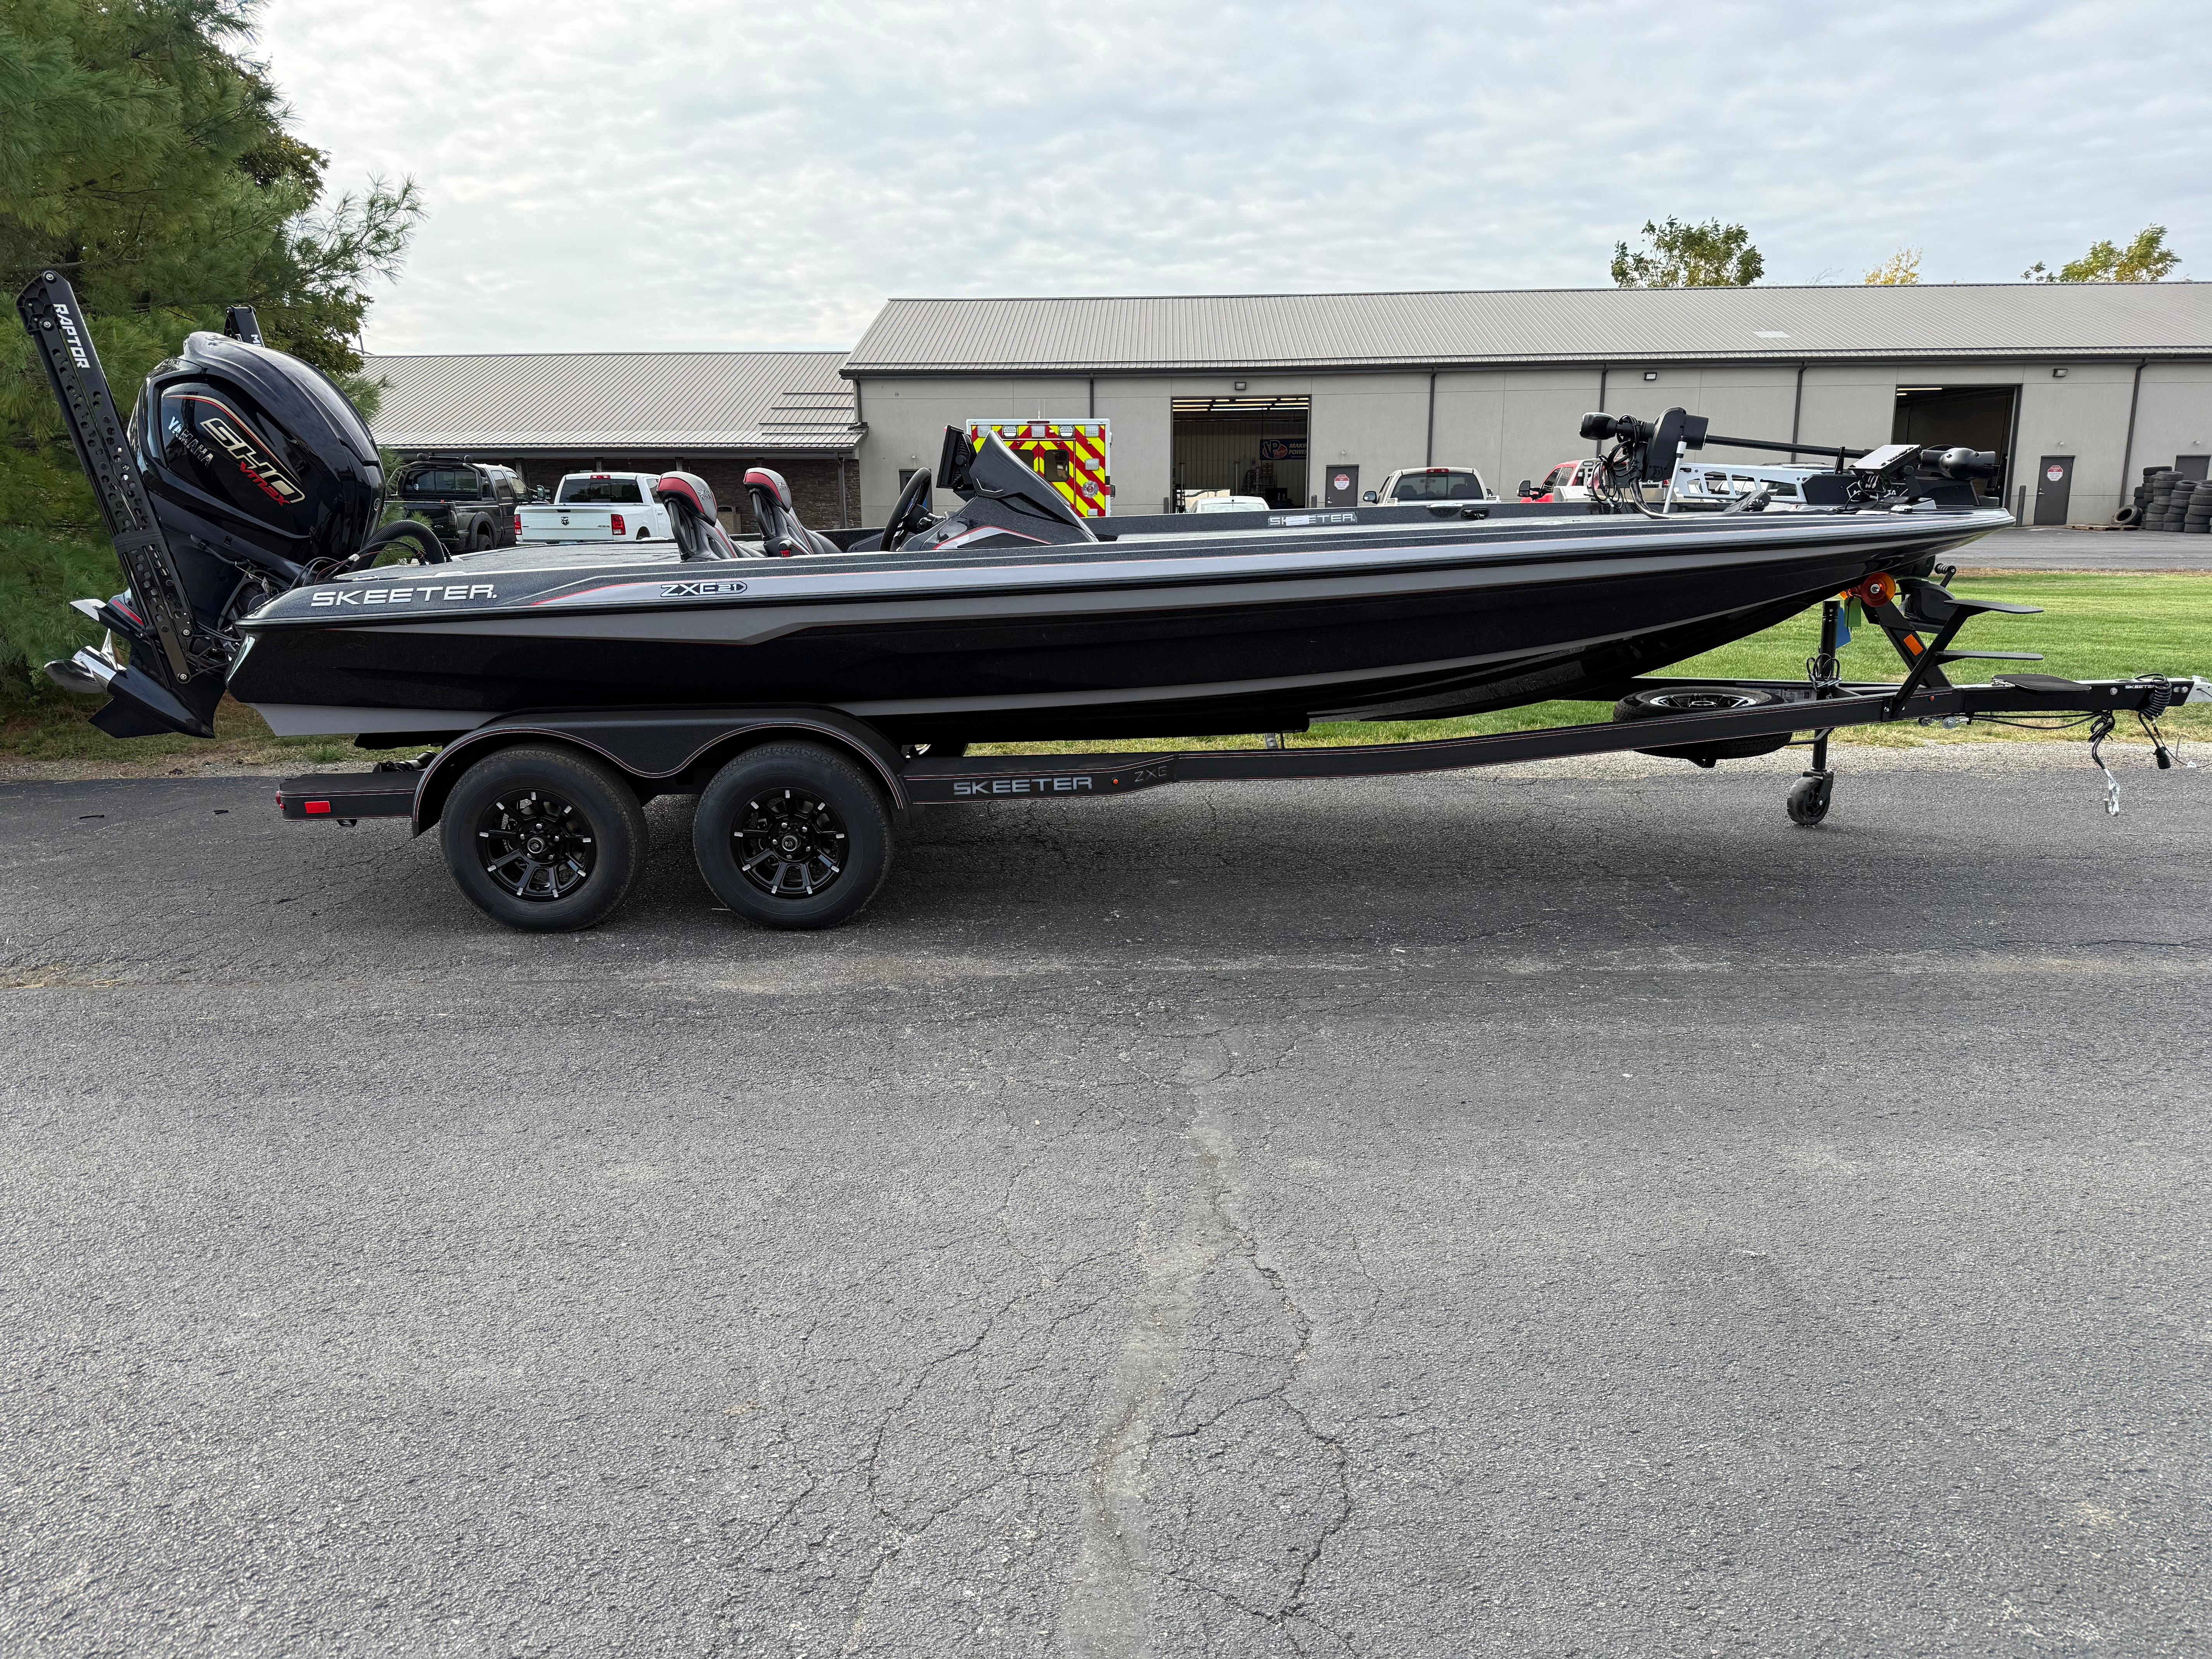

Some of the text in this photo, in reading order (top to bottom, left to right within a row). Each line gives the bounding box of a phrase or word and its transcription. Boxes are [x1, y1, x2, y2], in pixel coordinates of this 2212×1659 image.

[53, 304, 90, 368] RAPTOR
[168, 416, 213, 467] YAMAHA
[200, 418, 305, 503] SHO
[953, 766, 1168, 795] SKEETER ZXE
